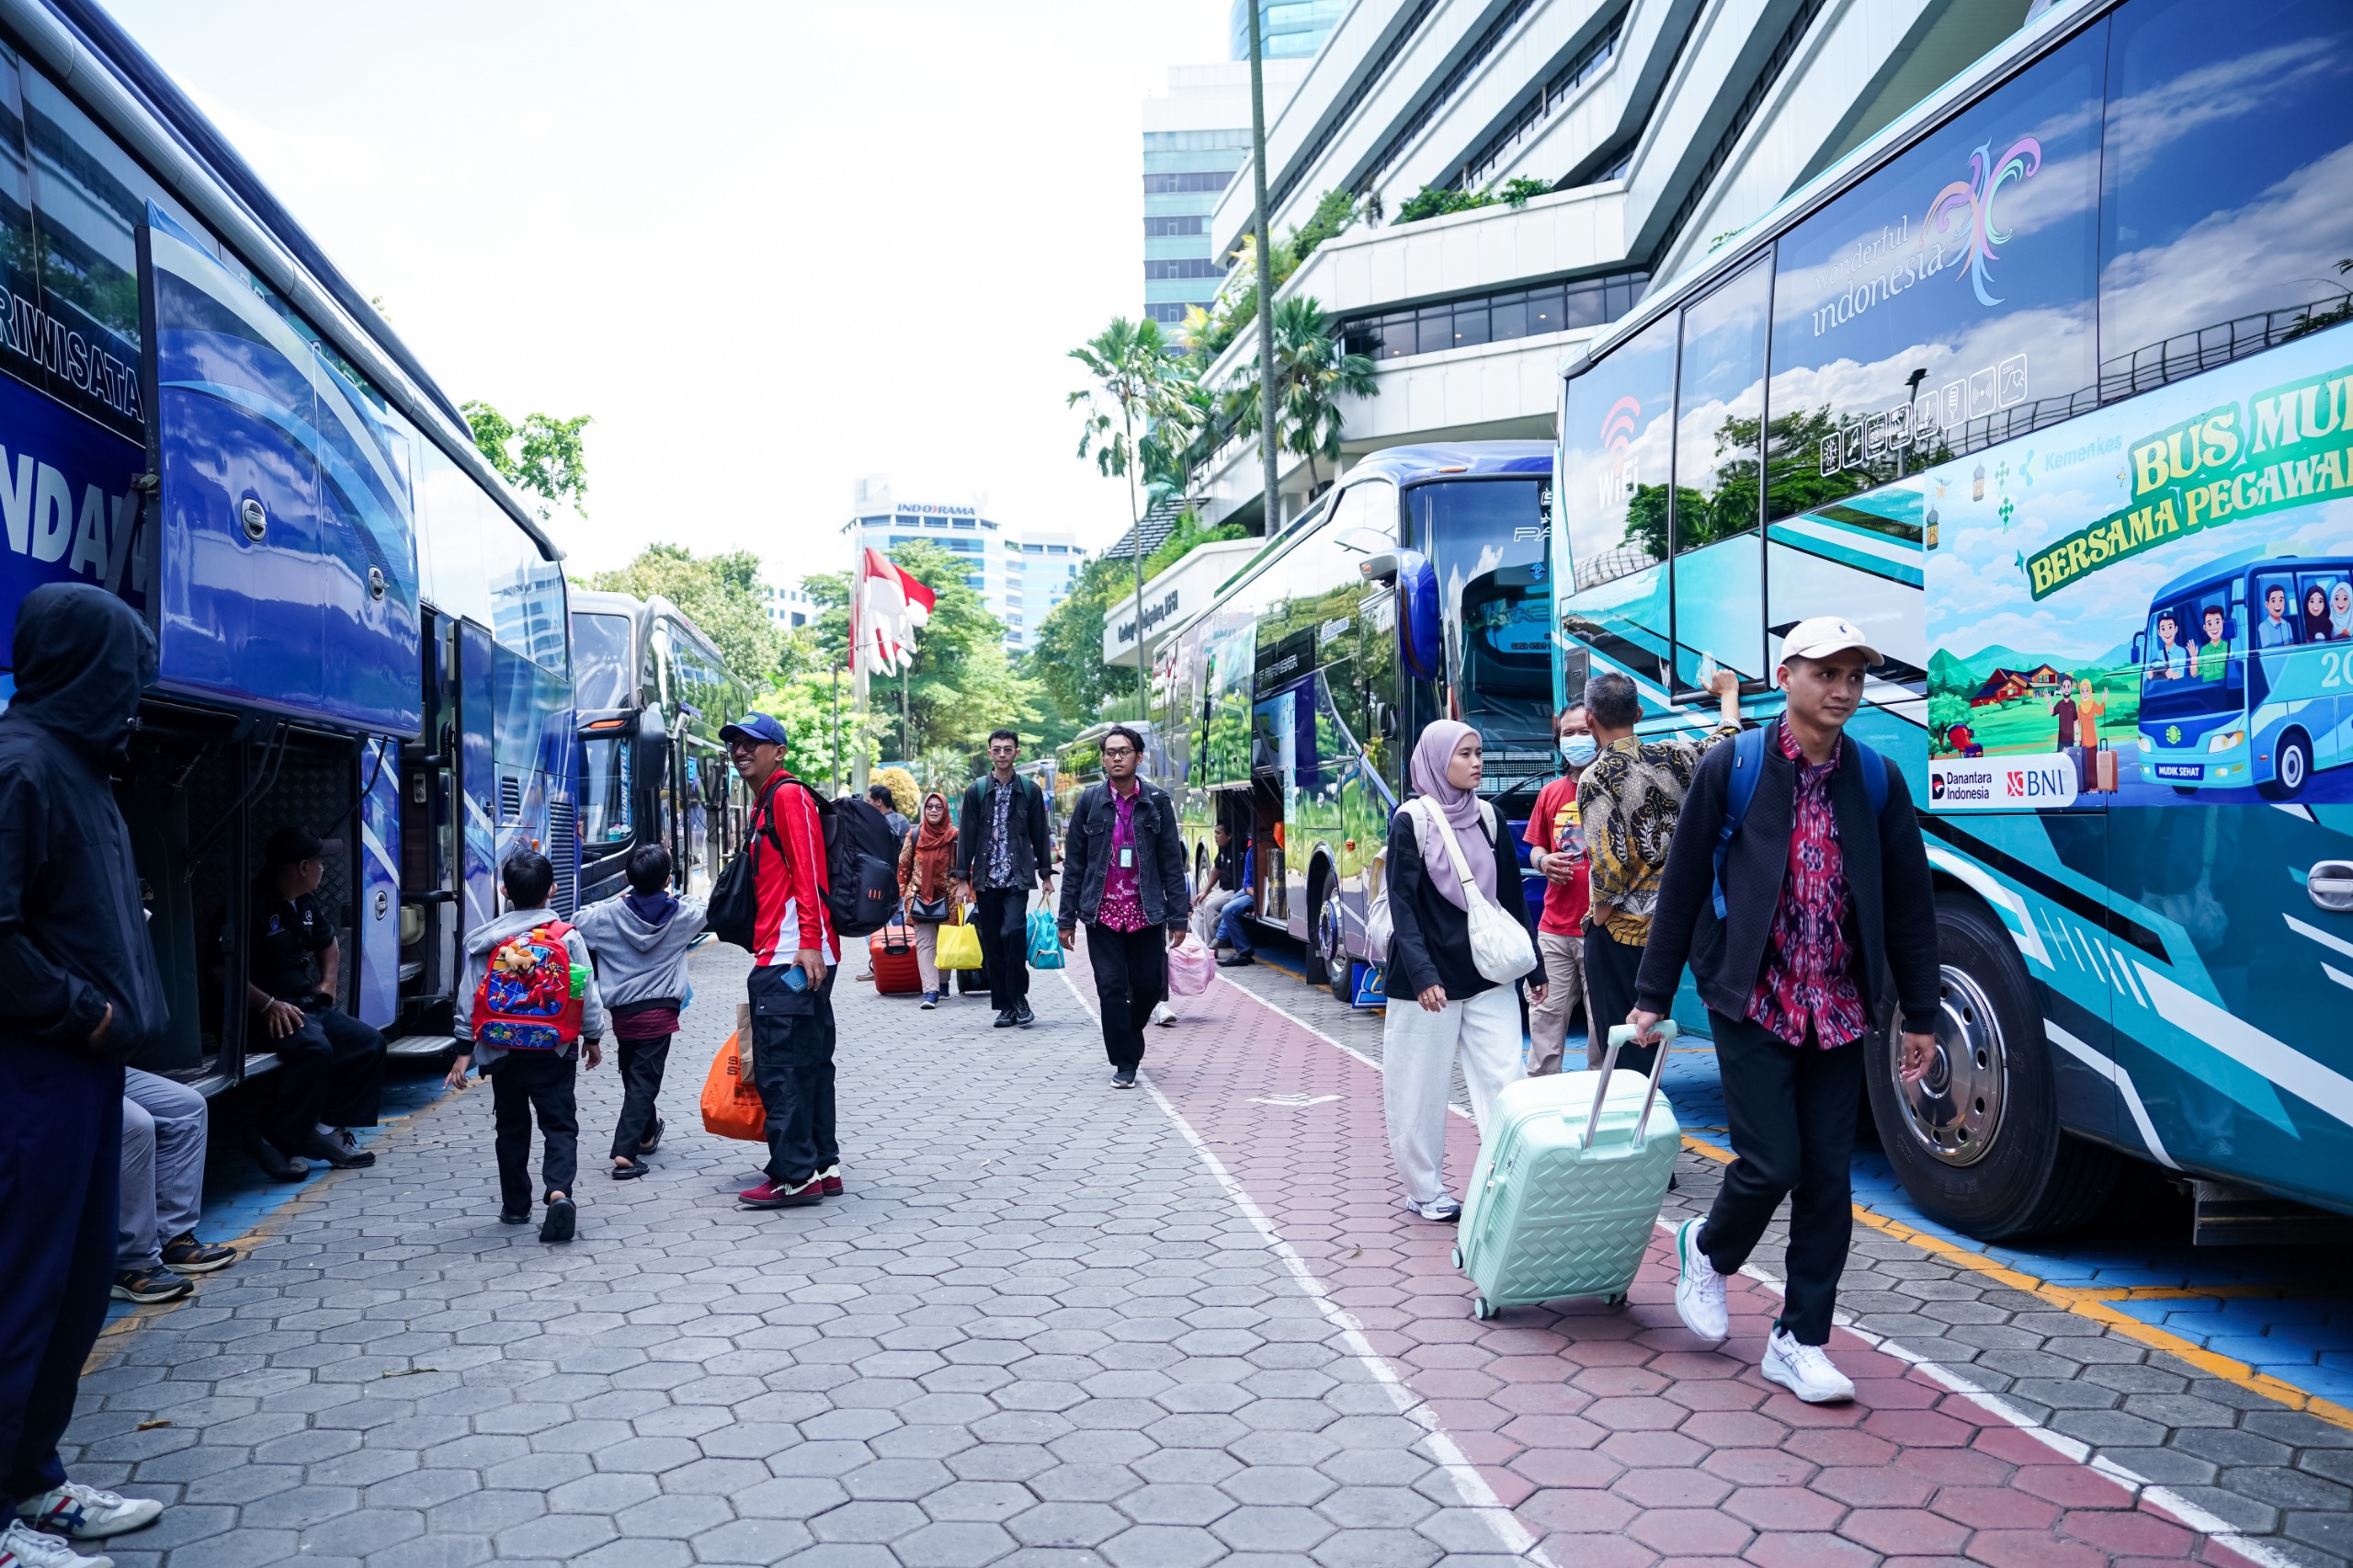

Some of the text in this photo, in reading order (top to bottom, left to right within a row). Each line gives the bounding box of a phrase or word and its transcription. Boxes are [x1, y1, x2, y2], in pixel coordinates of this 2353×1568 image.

[1815, 215, 1908, 293] wonderful
[1813, 243, 1948, 337] indonesia
[2044, 434, 2122, 472] Kemenkes
[2133, 412, 2234, 496] BUS
[2030, 501, 2180, 594] BERSAMA
[1947, 772, 1992, 785] Danantara
[2027, 769, 2064, 796] BNI
[2159, 766, 2200, 777] MUDIK SEHAT
[1947, 786, 1990, 800] Indonesia
